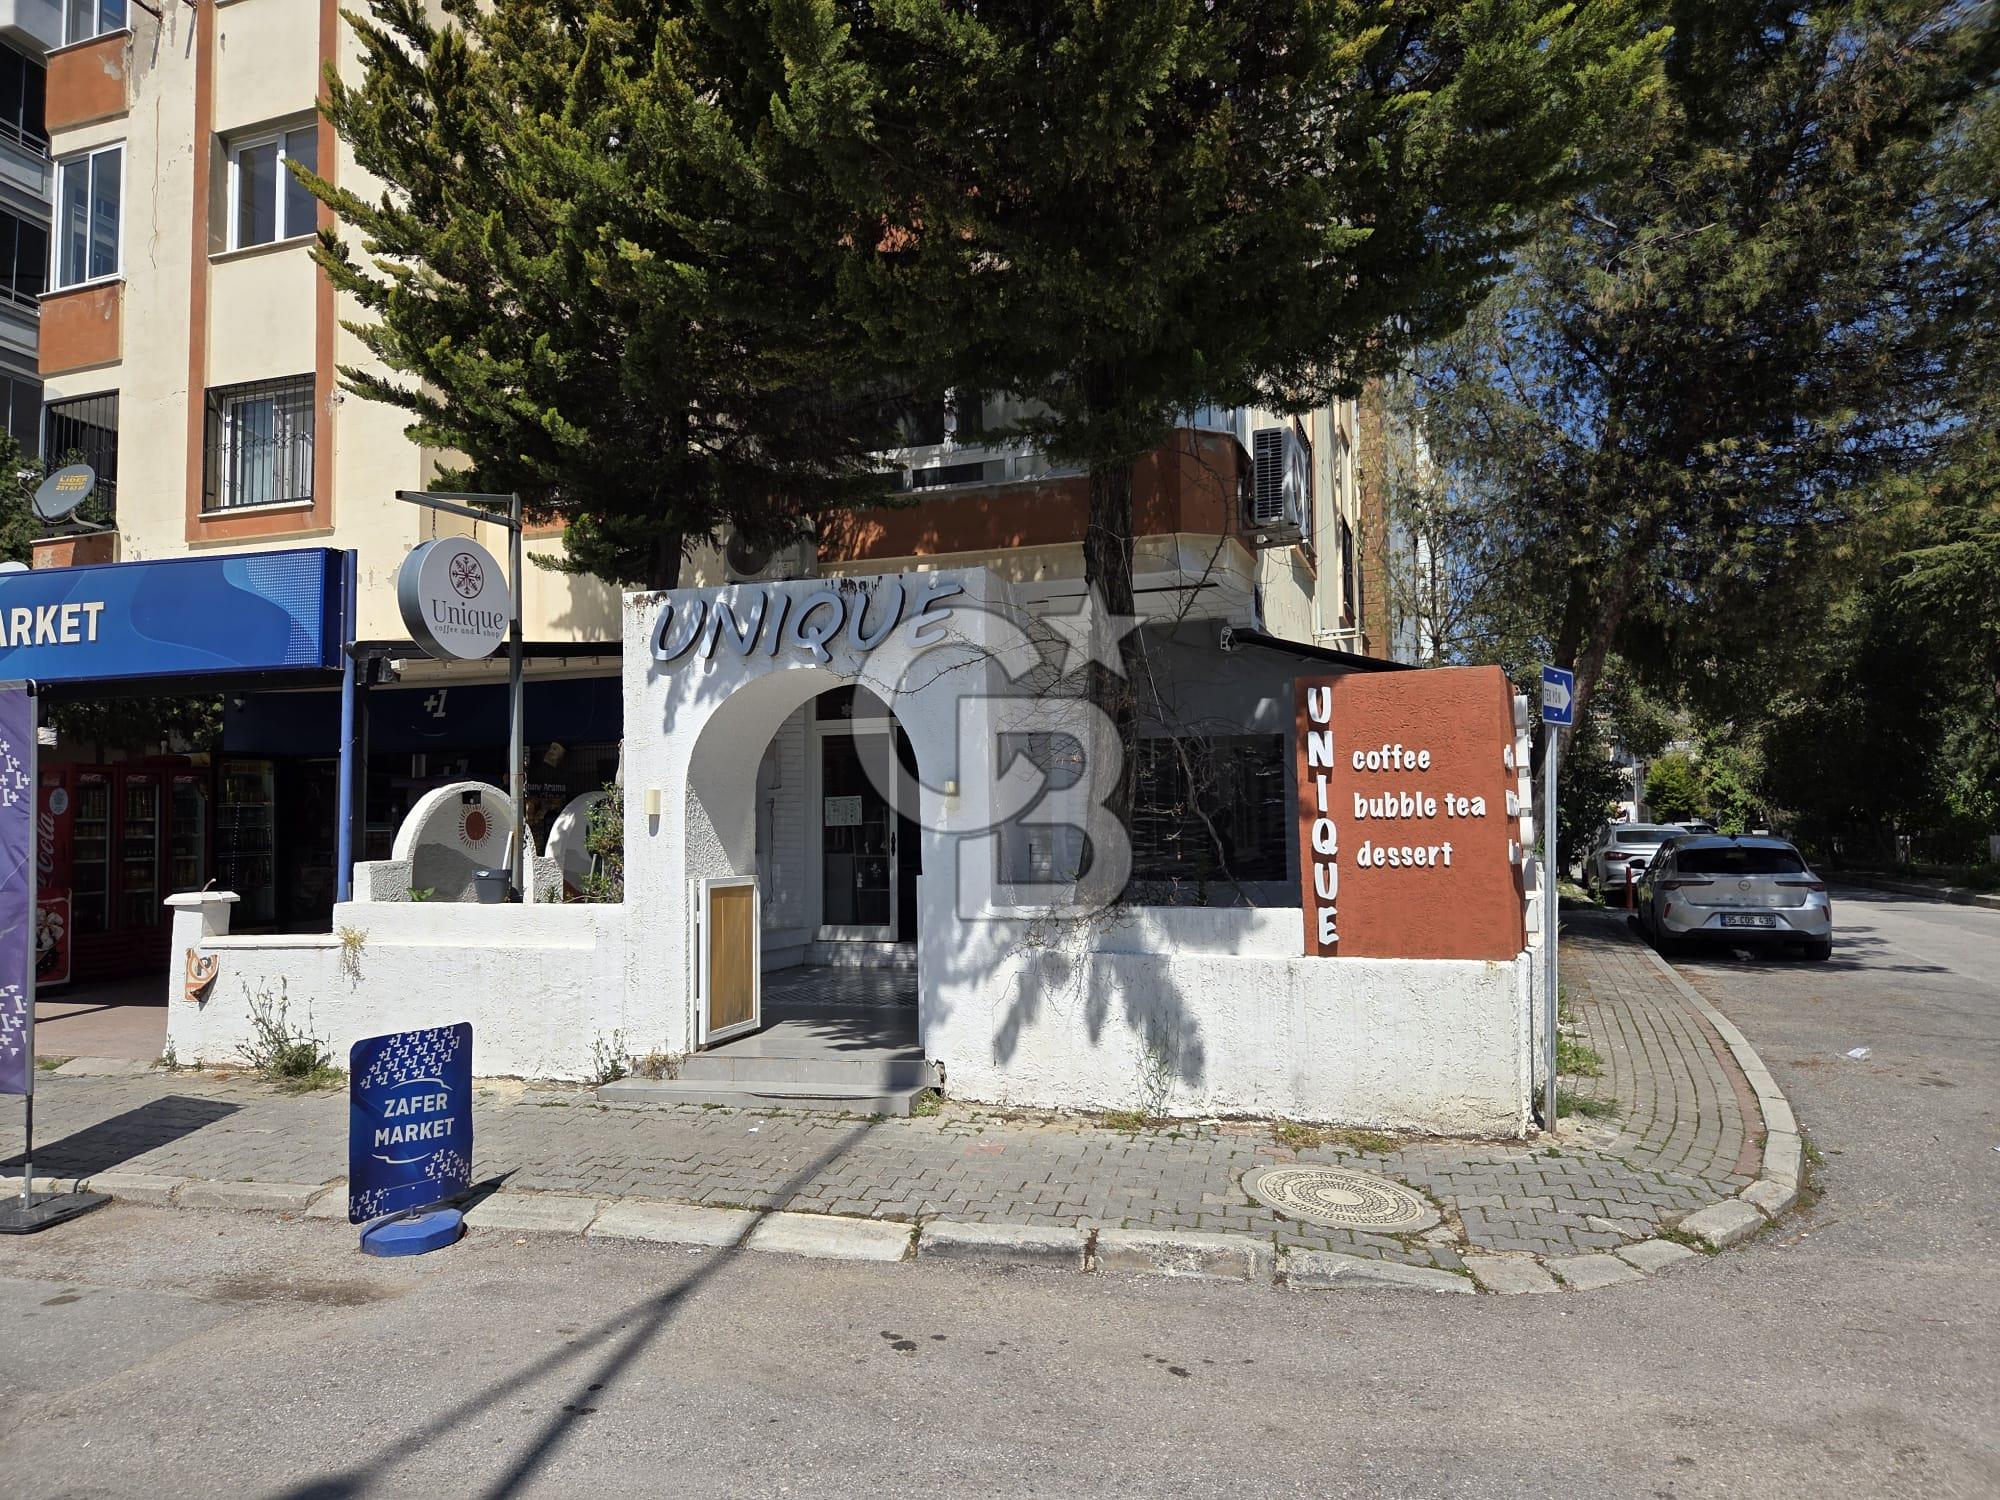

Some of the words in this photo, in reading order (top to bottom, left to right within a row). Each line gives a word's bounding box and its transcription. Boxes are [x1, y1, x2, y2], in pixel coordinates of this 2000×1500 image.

[432, 599, 503, 634] Unique
[650, 583, 965, 663] UNIQUE
[434, 625, 458, 634] coffee
[483, 629, 500, 639] shop
[1352, 744, 1431, 770] coffee
[1308, 686, 1339, 945] UNIQUE
[1354, 791, 1437, 819] bubble
[1445, 792, 1487, 816] tea
[1357, 840, 1453, 868] dessert
[384, 1093, 448, 1118] ZAFER
[374, 1117, 455, 1148] MARKET
